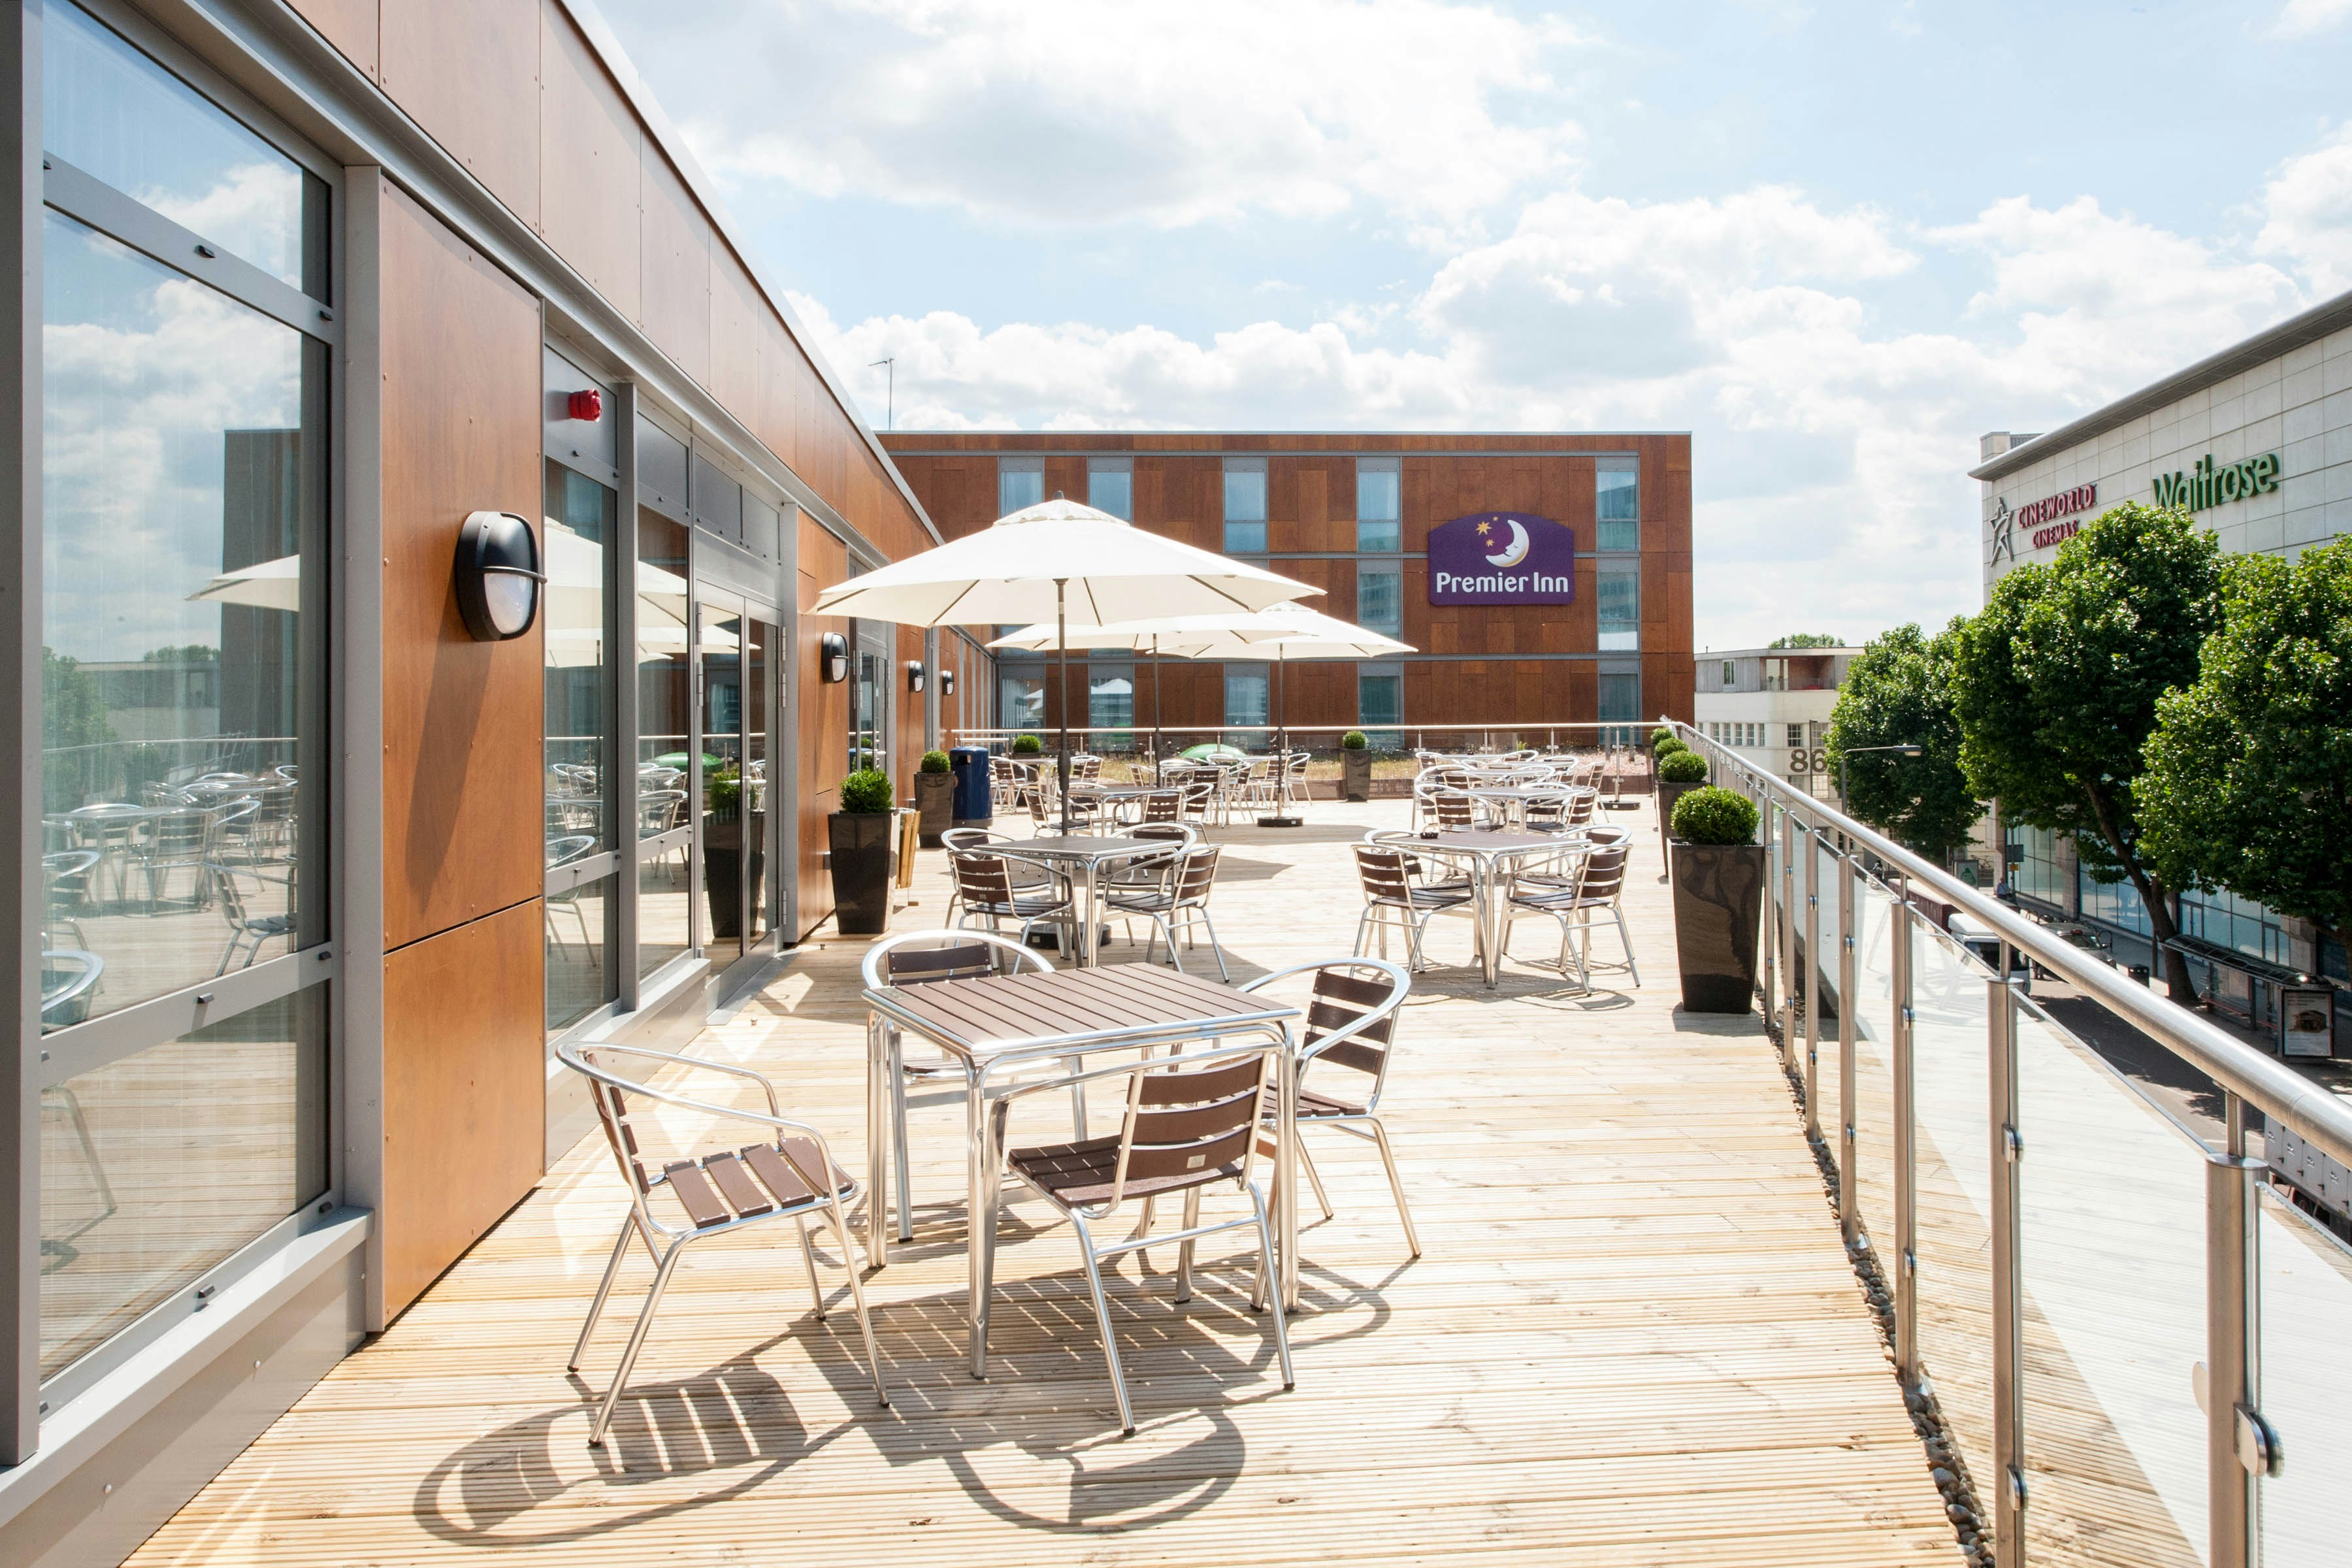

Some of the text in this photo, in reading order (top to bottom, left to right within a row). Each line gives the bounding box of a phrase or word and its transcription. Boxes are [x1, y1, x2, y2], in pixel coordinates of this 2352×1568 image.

[2152, 454, 2279, 514] Waitrose
[2018, 485, 2095, 529] CINEWORLD
[2033, 520, 2078, 548] CINEMAS
[1437, 572, 1568, 593] Premier Inn
[1790, 749, 1828, 772] 86
